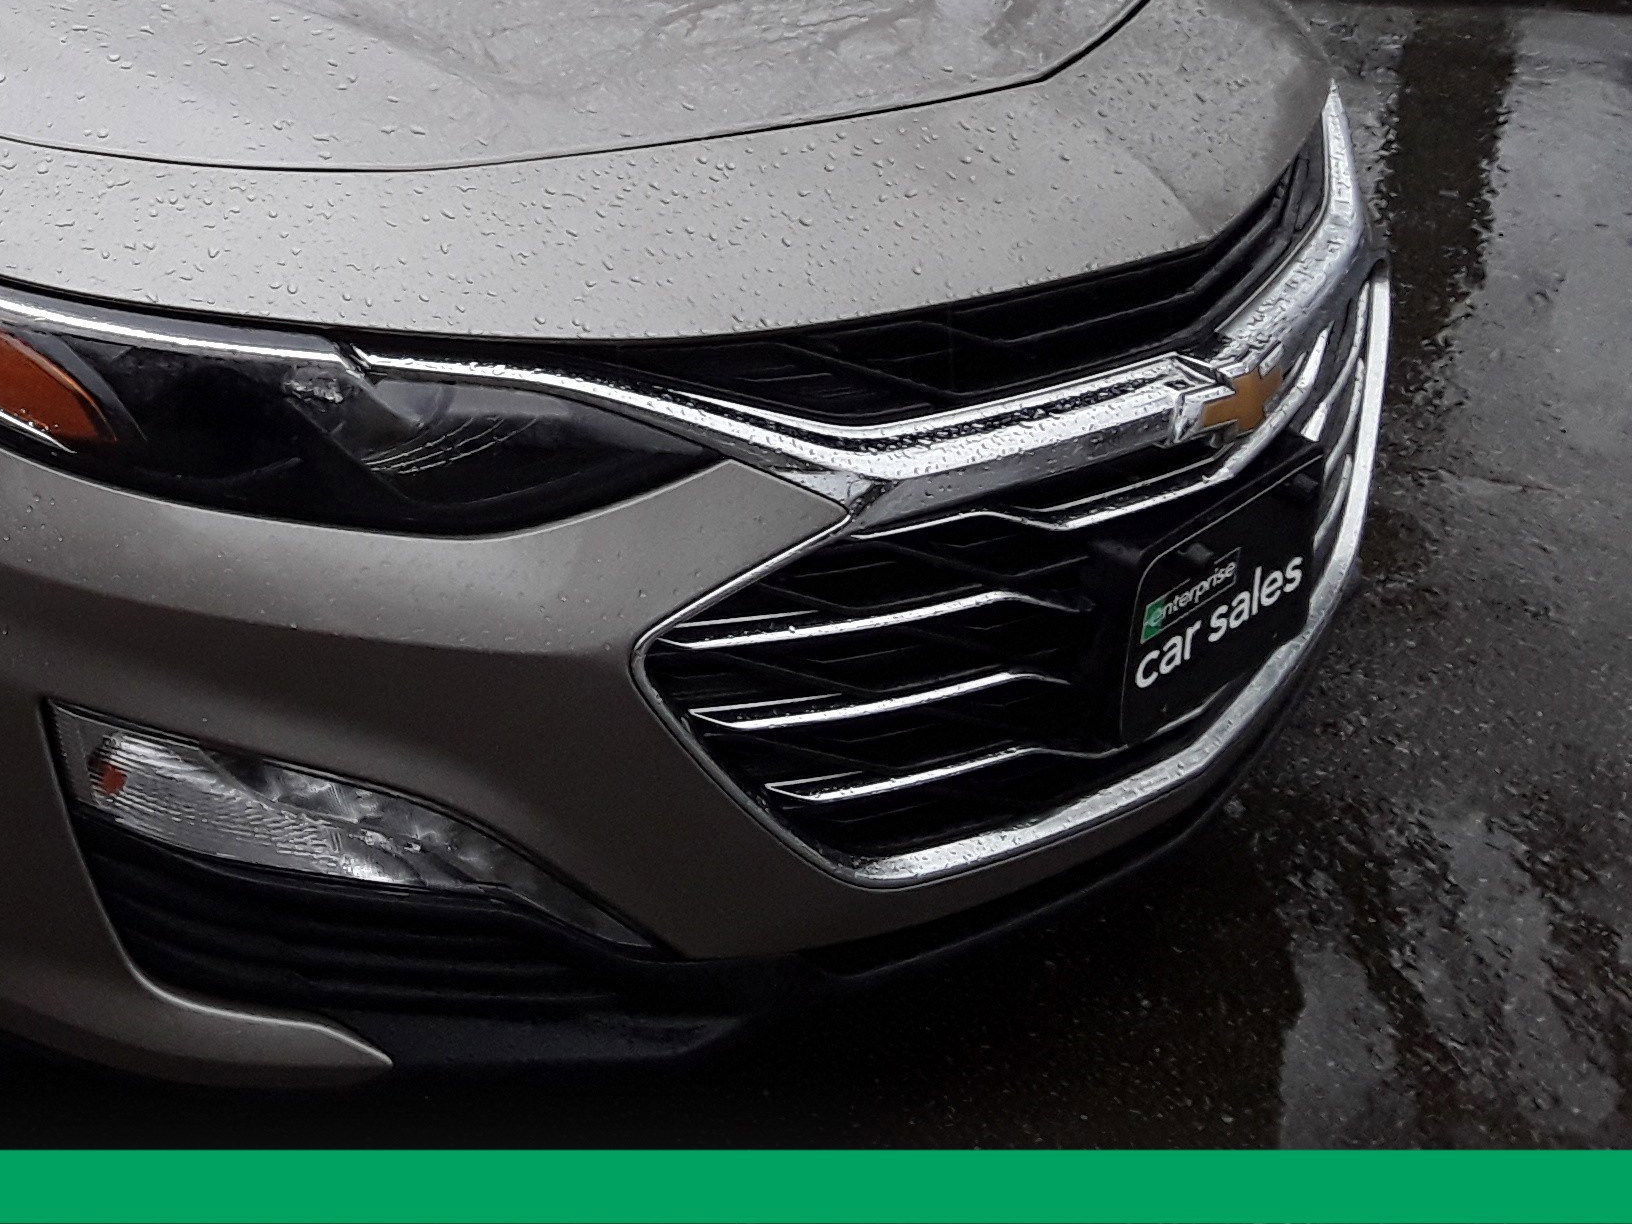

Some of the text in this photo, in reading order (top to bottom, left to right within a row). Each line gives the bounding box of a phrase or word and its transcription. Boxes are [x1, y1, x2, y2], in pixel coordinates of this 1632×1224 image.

[1134, 556, 1303, 688] car sales
[1143, 561, 1236, 627] enterprise
